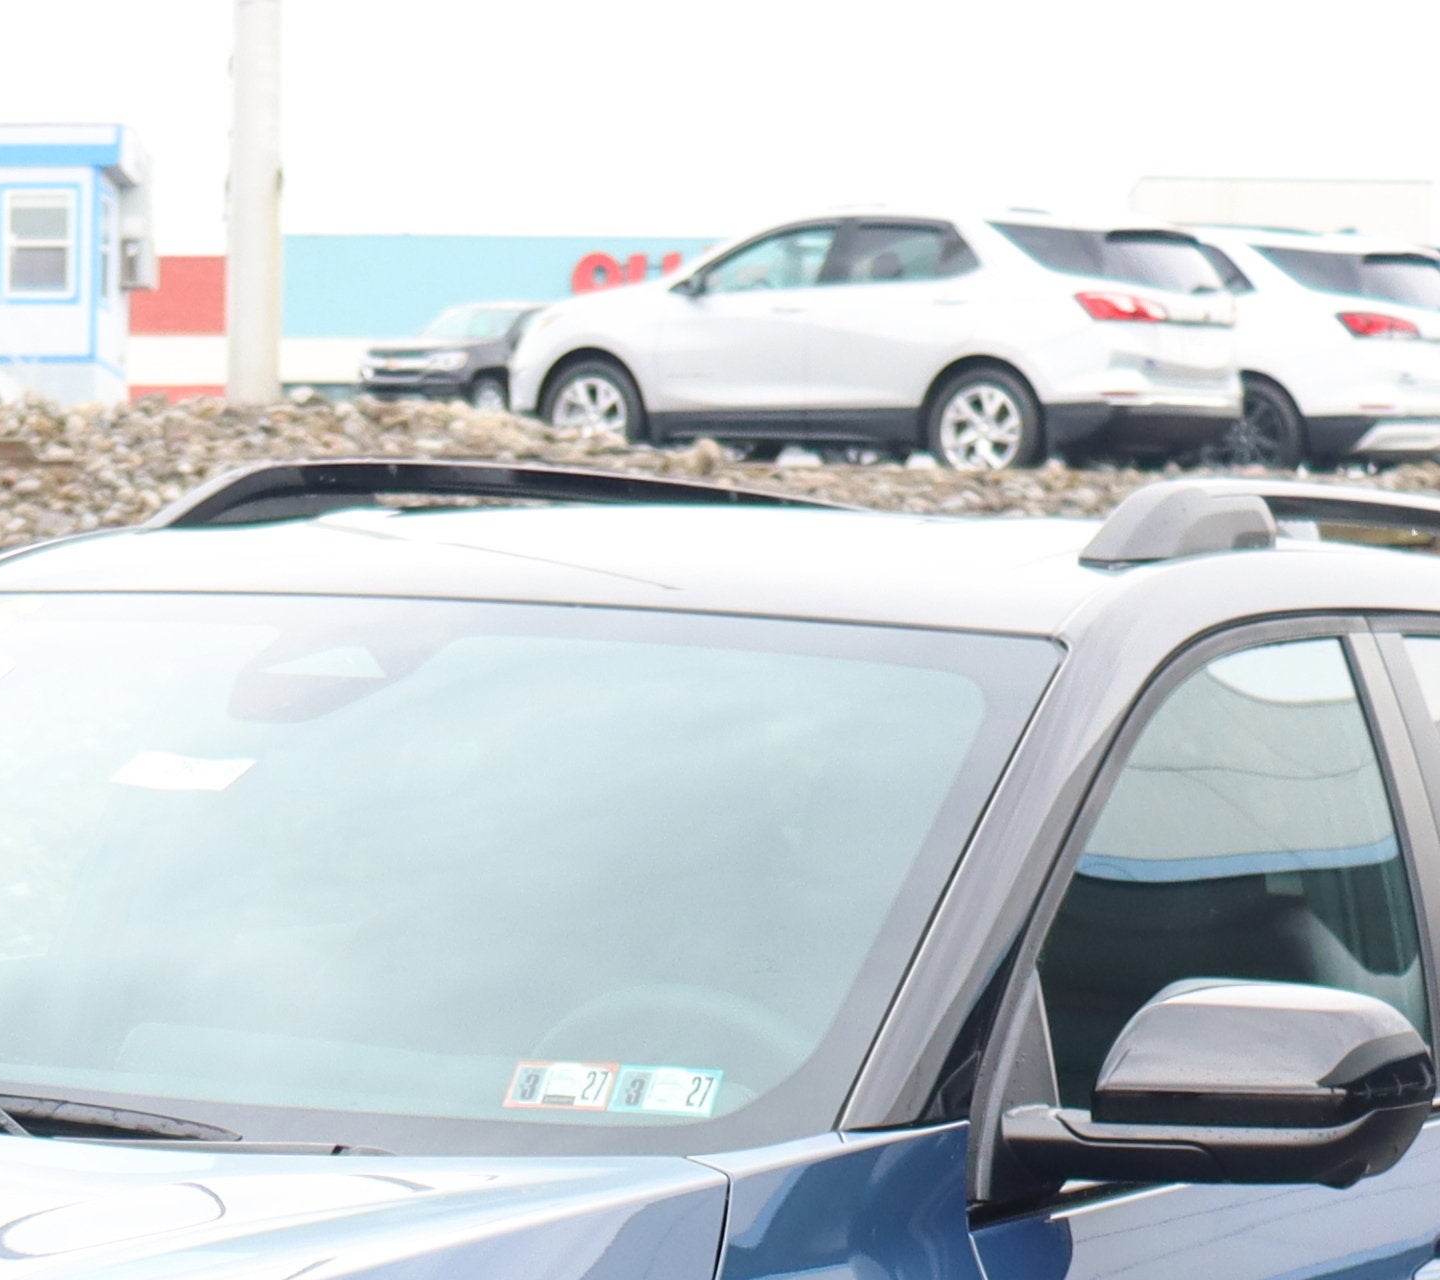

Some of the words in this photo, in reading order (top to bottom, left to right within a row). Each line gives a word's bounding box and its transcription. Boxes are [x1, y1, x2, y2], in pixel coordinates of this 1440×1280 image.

[580, 1070, 610, 1103] 27
[625, 1078, 647, 1107] 3
[685, 1076, 716, 1109] 27
